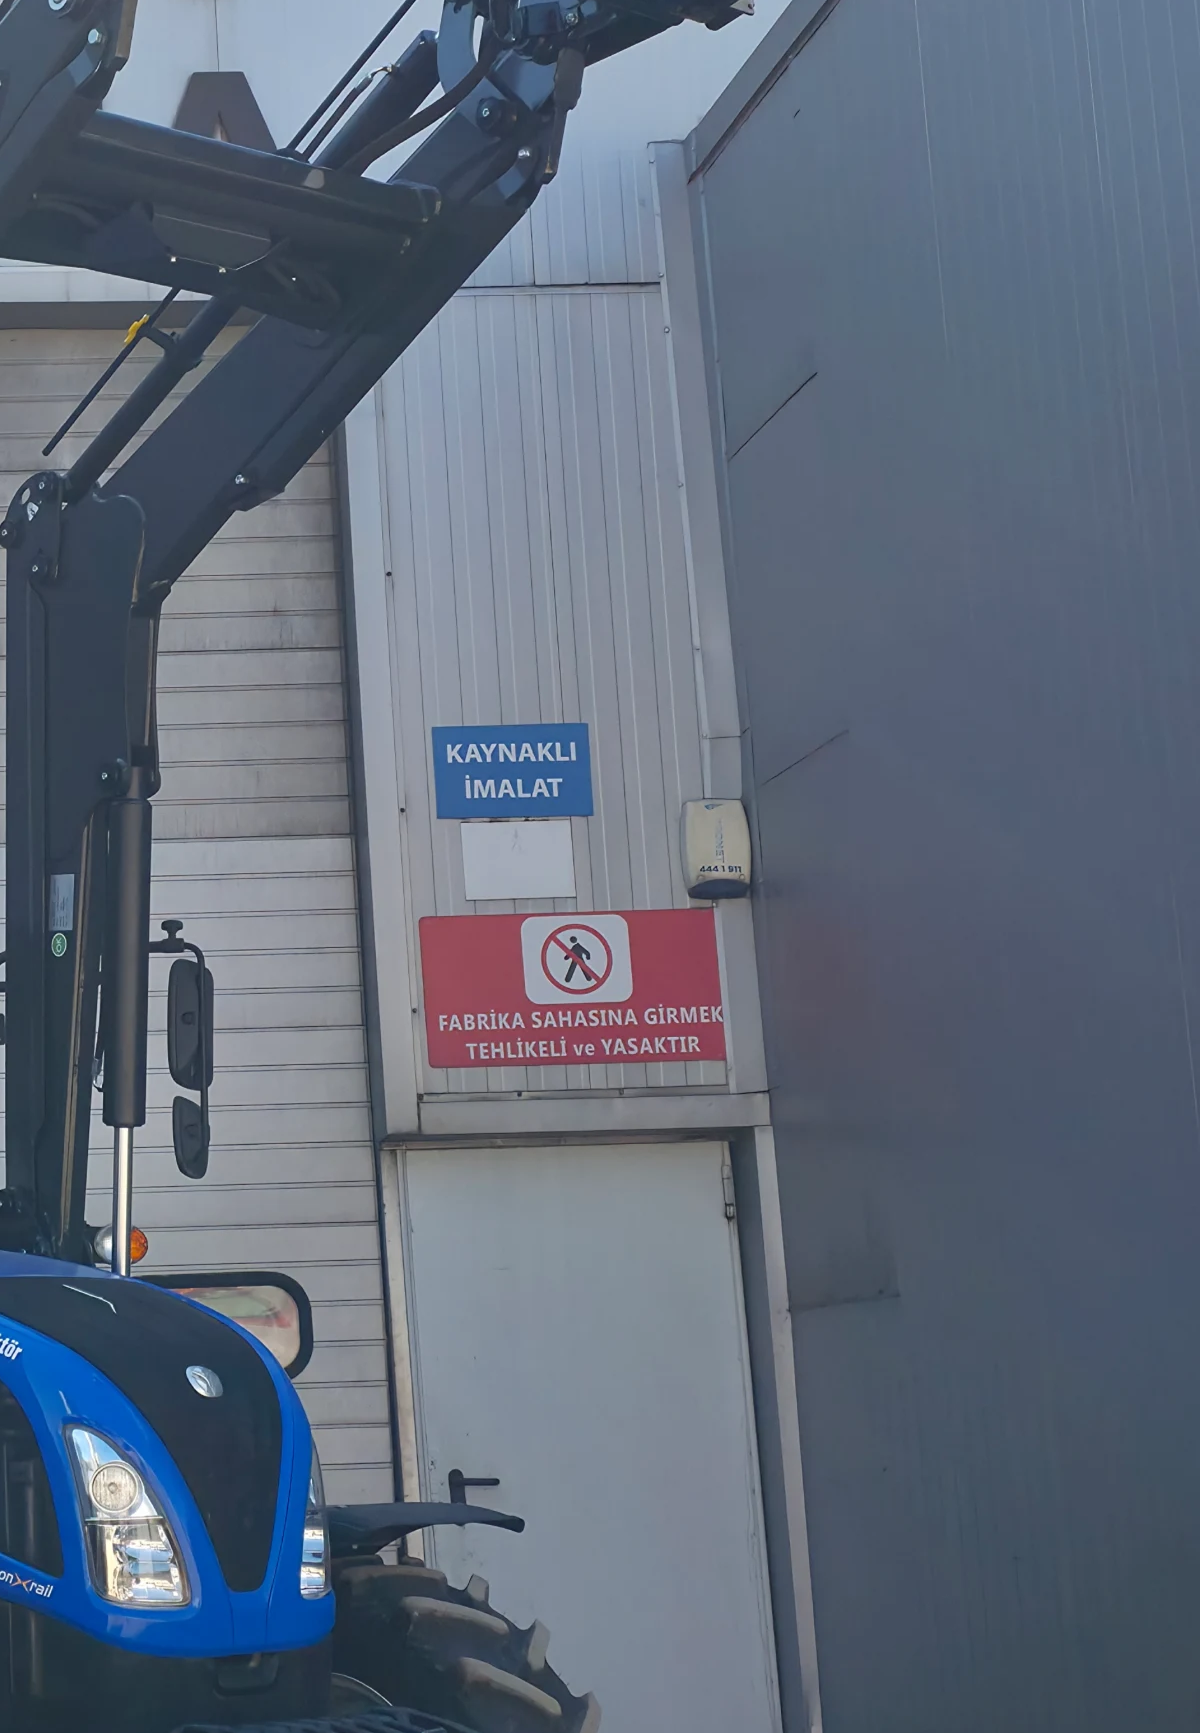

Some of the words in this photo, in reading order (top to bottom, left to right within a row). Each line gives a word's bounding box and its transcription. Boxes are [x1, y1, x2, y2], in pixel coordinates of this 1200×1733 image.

[445, 741, 577, 764] KAYNAKLI
[464, 774, 563, 799] İMALAT
[700, 865, 719, 873] 444
[728, 865, 742, 874] 911
[438, 1008, 525, 1032] FABRİKA
[530, 1008, 638, 1029] SAHASINA
[643, 1003, 724, 1025] GİRMEK
[465, 1036, 567, 1060] TEHLİKELİ
[573, 1043, 596, 1057] ve
[600, 1036, 701, 1056] YASAKTIR
